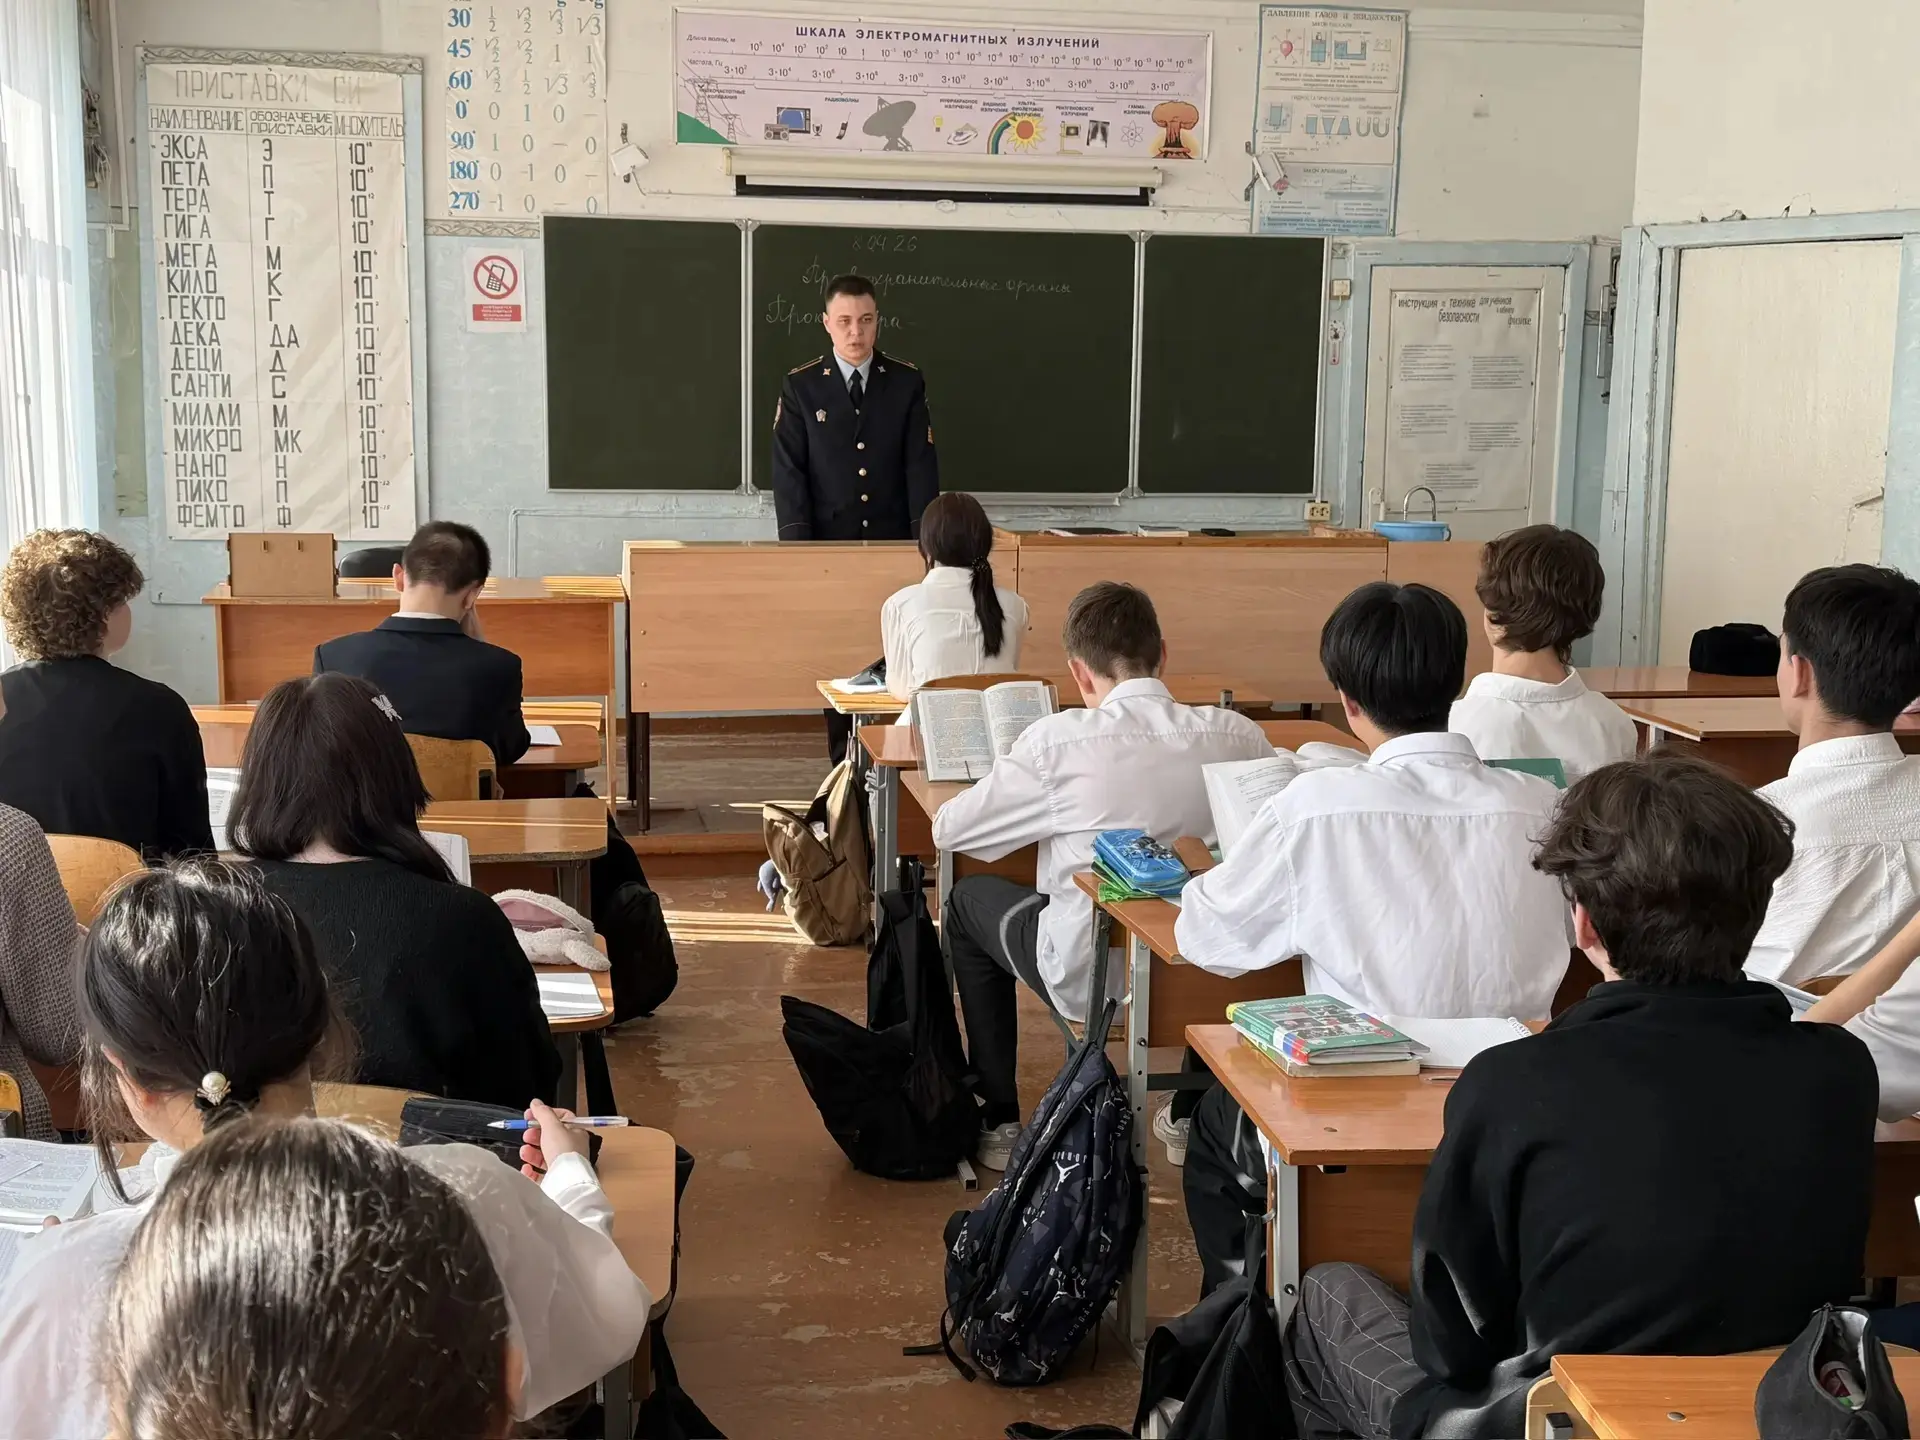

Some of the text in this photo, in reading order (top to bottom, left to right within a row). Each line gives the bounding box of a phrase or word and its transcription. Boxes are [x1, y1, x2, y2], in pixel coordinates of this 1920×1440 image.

[796, 26, 1100, 48] ШКАЛА ЭЛЕКТРОМАГНИТНЫХ ИЗЛУЧЕНИЙ
[715, 60, 723, 68] Гц
[838, 47, 847, 55] 10
[175, 69, 362, 105] ПРИСТАВКИ СИ
[150, 107, 405, 138] НАИМЕНОВАНИЕ ОБОЗНАЧЕНИЕ МНОЖИТЕЛЬ
[250, 123, 333, 136] ПРИСТАВКИ
[160, 134, 209, 160] ЭКСА
[261, 138, 273, 162] Э
[160, 161, 210, 187] ПЕТА
[263, 164, 274, 189] П
[162, 187, 211, 213] ТЕРА
[264, 190, 275, 215] Т
[163, 213, 212, 239] ГИГА
[264, 217, 275, 241] Г
[165, 242, 218, 268] МЕГА
[266, 245, 282, 270] М
[166, 269, 218, 294] КИЛО
[267, 272, 283, 297] К
[1005, 279, 1073, 301] органы
[167, 295, 226, 320] ГЕКТО
[268, 298, 281, 322] Г
[170, 321, 221, 347] ДЕКА
[269, 324, 300, 348] ДА
[170, 347, 222, 373] ДЕЦИ
[269, 350, 287, 373] Д
[171, 373, 232, 398] САНТИ
[272, 376, 286, 399] С
[172, 402, 242, 426] МИЛЛИ
[273, 404, 288, 428] М
[173, 428, 242, 452] МИКРО
[274, 430, 302, 453] МК
[175, 453, 227, 478] НАНО
[276, 455, 287, 478] Н
[176, 479, 228, 503] ПИКО
[276, 480, 288, 503] П
[177, 504, 245, 528] ФЕМТО
[277, 505, 292, 529] Ф
